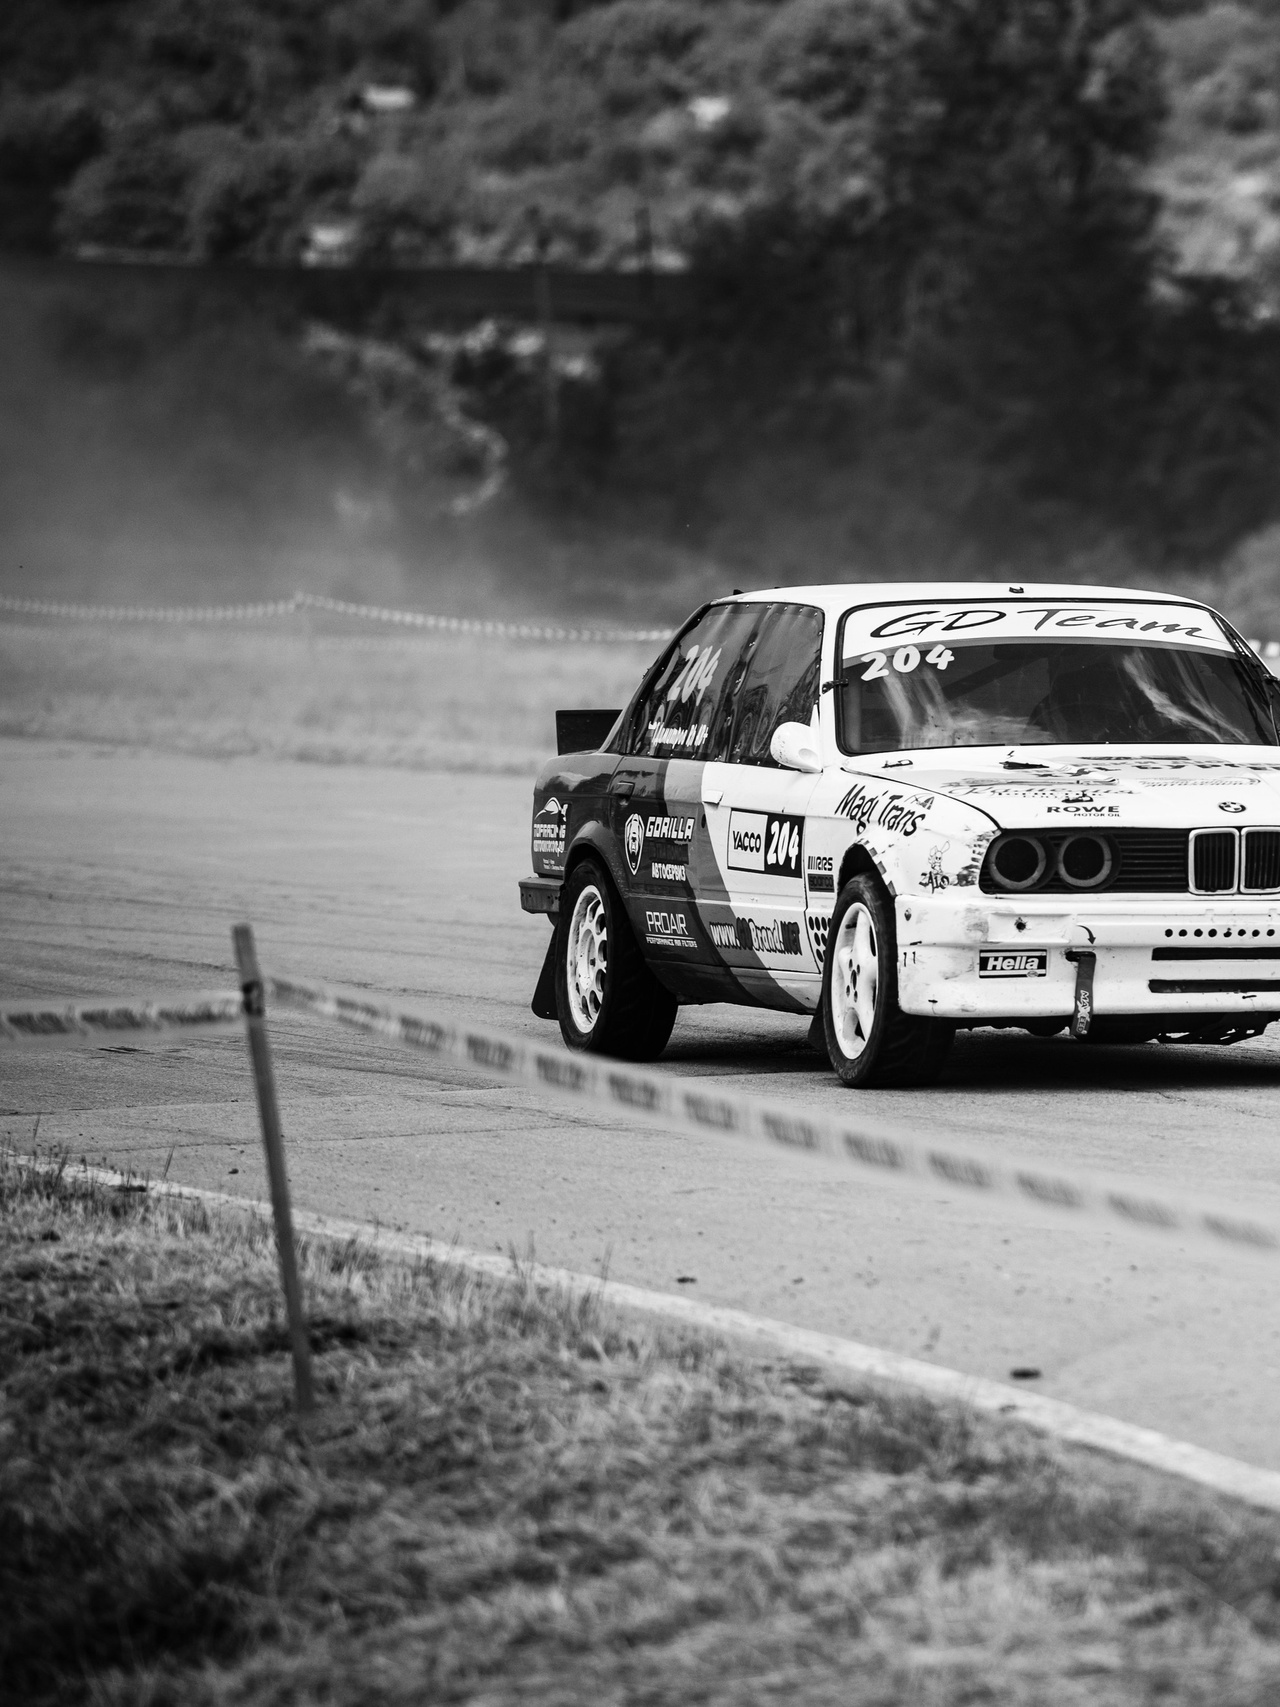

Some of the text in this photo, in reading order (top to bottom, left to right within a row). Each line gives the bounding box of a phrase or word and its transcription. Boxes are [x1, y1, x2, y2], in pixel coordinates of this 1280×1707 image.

[869, 608, 1228, 644] GD Team
[667, 645, 722, 706] 204
[860, 643, 954, 682] 204
[834, 783, 926, 837] Magi Trans
[1046, 805, 1120, 813] ROWE
[645, 816, 695, 840] GORILLA
[732, 820, 799, 870] YACCO 204
[645, 911, 689, 935] PROAIR
[986, 956, 1039, 971] Hella
